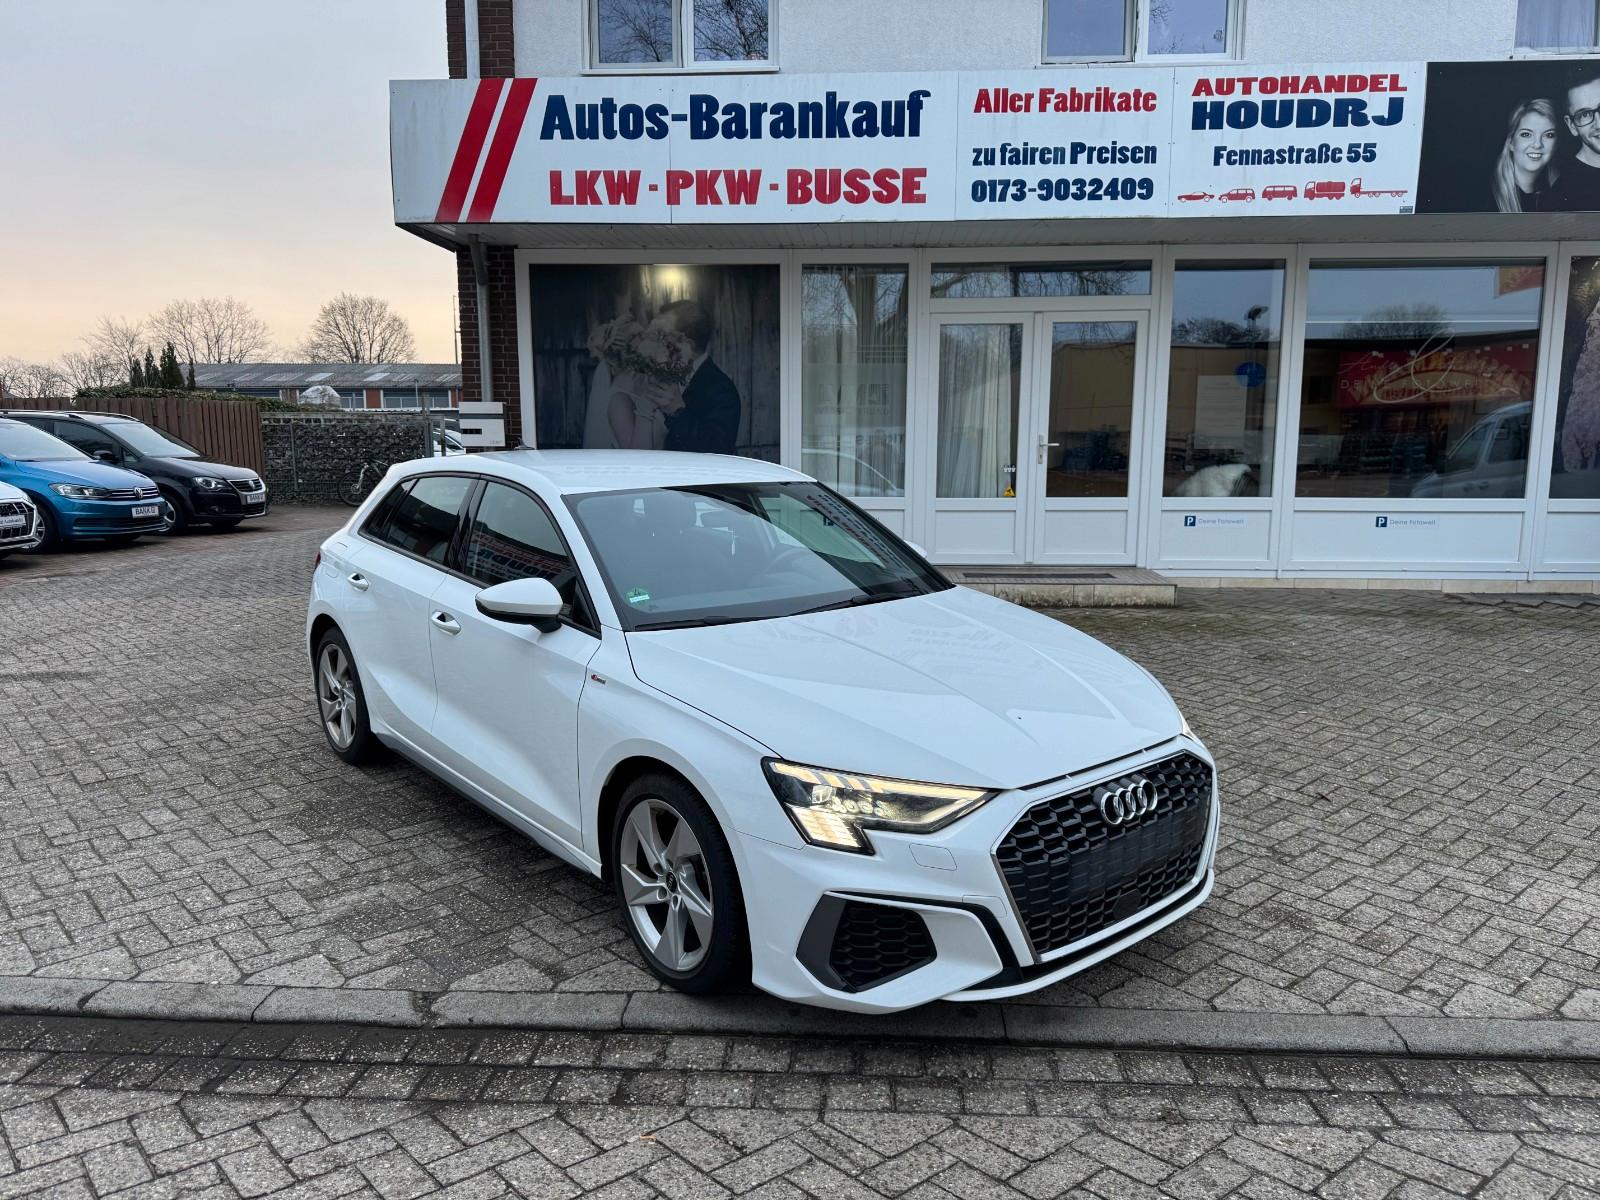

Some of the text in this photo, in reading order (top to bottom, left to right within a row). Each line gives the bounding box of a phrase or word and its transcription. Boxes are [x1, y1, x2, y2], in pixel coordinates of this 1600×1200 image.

[1192, 74, 1406, 97] AUTOHANDEL
[973, 86, 1157, 114] Aller Fabrikate
[1191, 96, 1405, 131] HOUDRJ
[540, 89, 931, 141] Autos-Barankauf
[972, 140, 1157, 168] zu fairen Preisen
[1213, 142, 1378, 168] Fennastraße 55
[549, 170, 641, 206] LKW
[665, 169, 762, 206] PKW
[786, 167, 928, 205] BUSSE
[971, 178, 1154, 203] 0173-9032409
